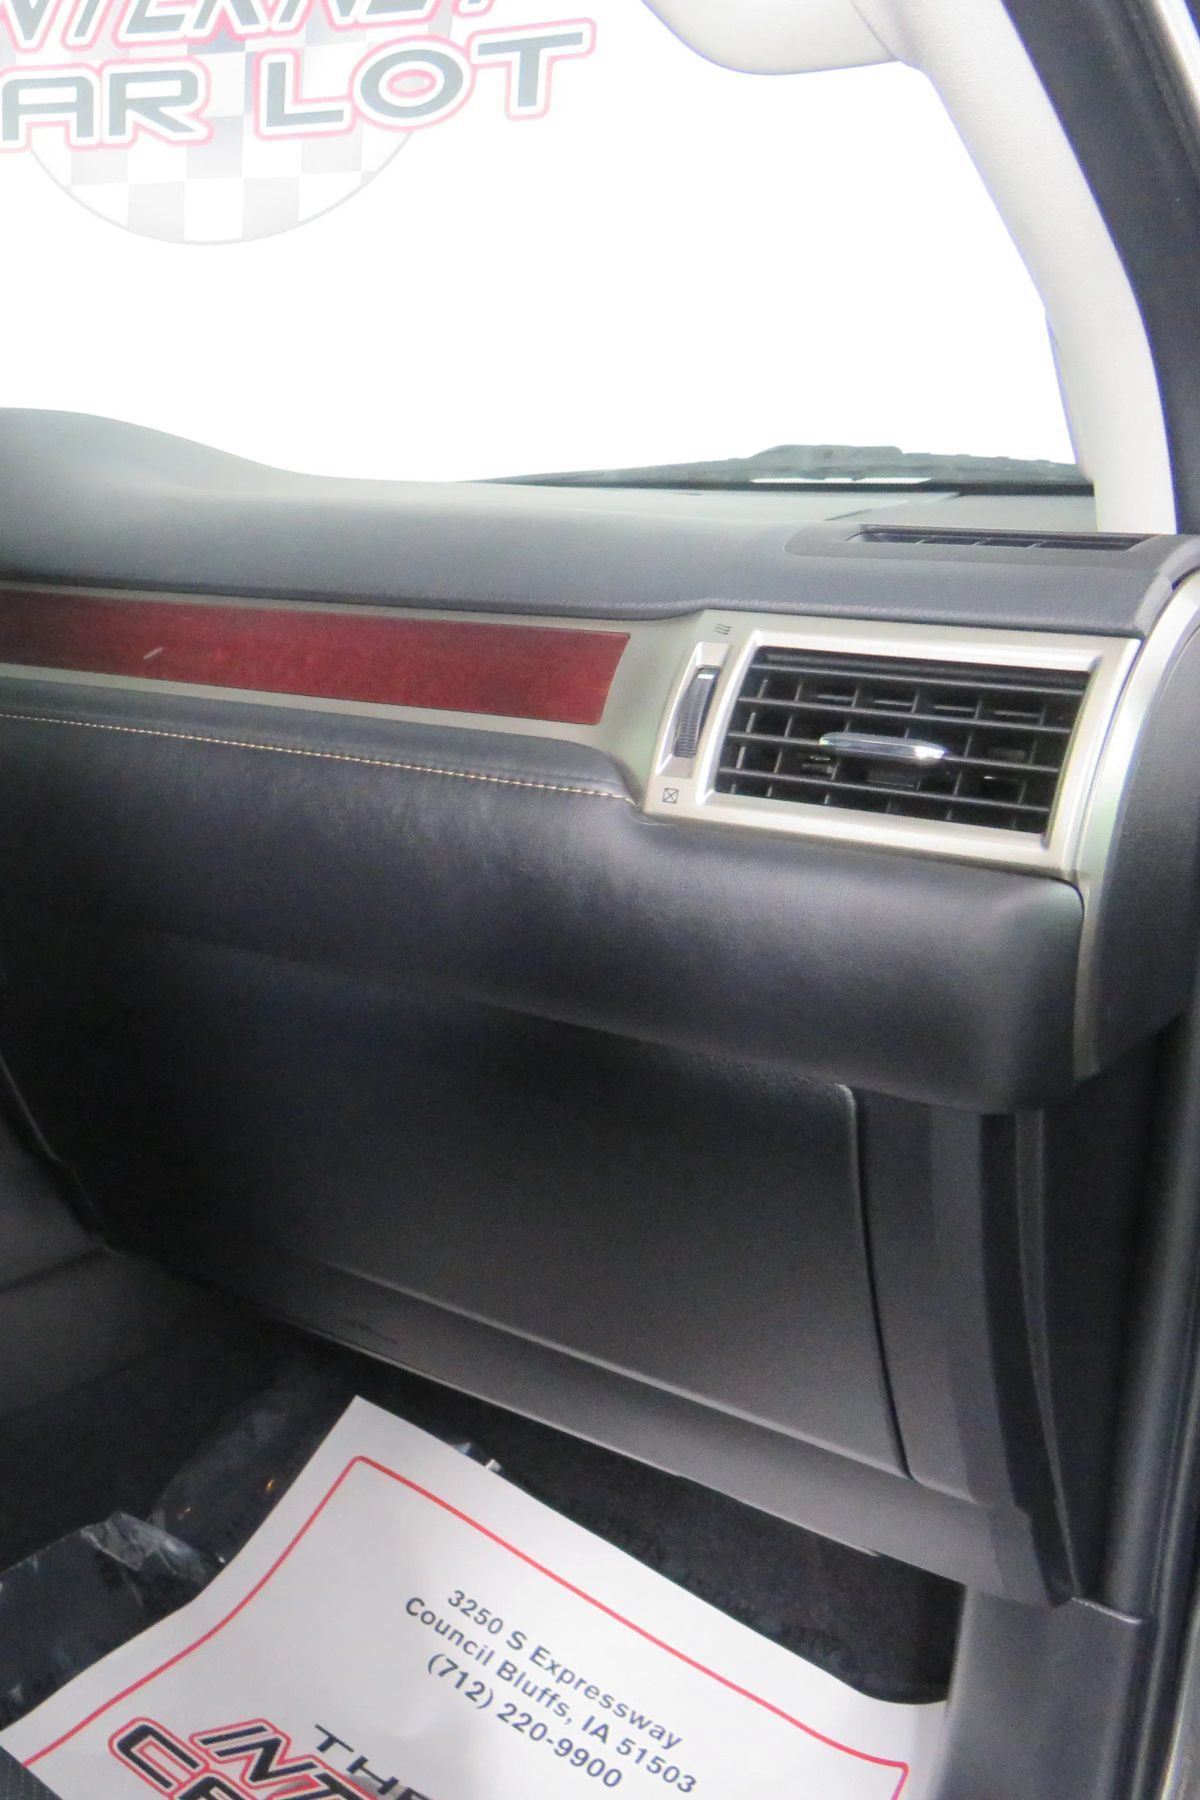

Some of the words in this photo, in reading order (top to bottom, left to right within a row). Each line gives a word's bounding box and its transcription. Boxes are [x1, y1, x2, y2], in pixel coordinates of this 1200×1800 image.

[264, 30, 585, 129] LOT
[405, 1597, 495, 1666] Council
[496, 1660, 574, 1726] Bluffs,
[580, 1715, 611, 1744] IA
[615, 1738, 698, 1794] 51503
[427, 1653, 495, 1710] (712)
[496, 1702, 624, 1789] 220-9900
[447, 1589, 504, 1635] 3250
[506, 1630, 528, 1651] S
[529, 1645, 683, 1750] Expressway
